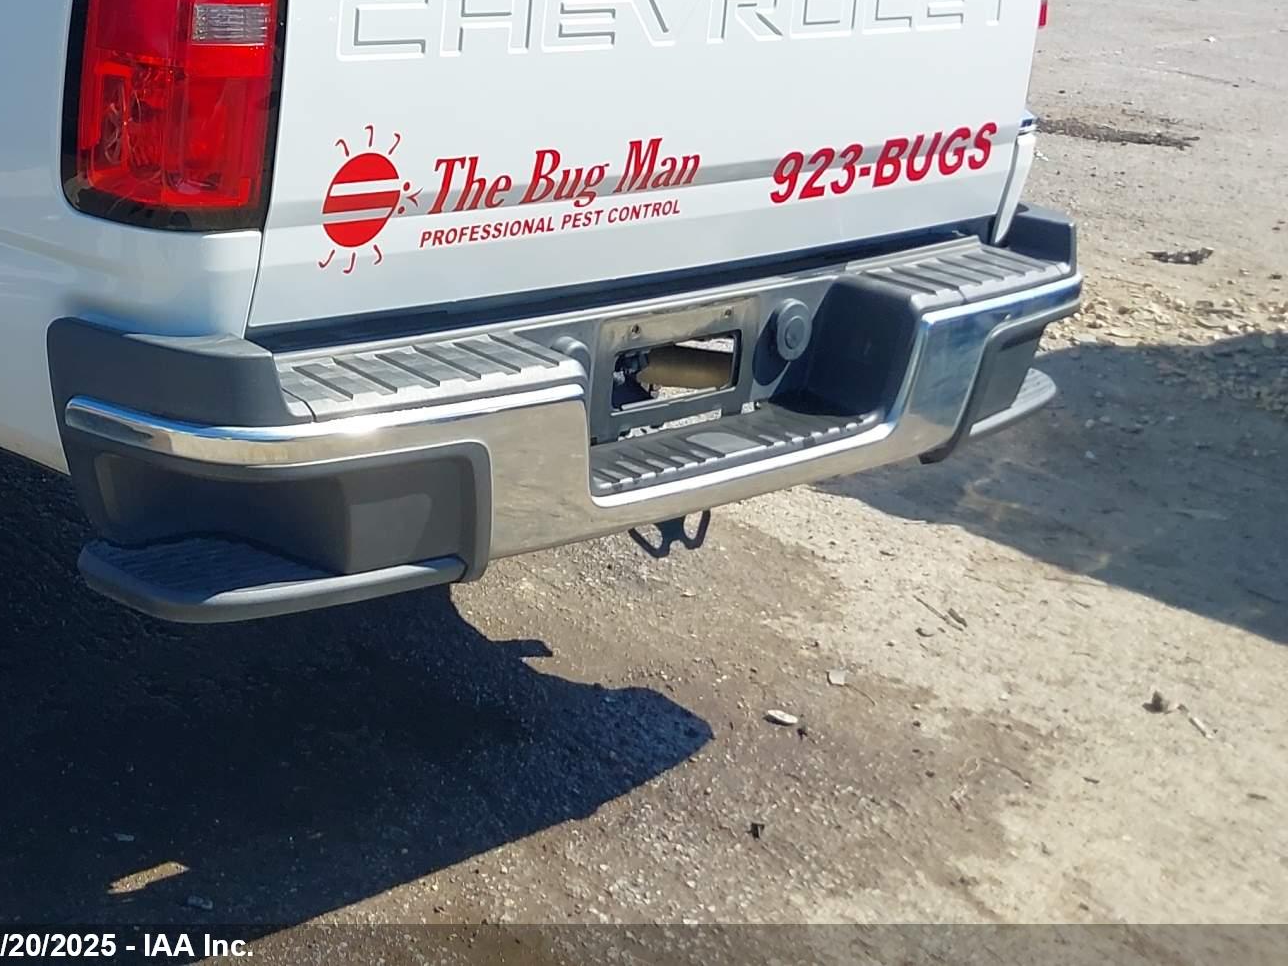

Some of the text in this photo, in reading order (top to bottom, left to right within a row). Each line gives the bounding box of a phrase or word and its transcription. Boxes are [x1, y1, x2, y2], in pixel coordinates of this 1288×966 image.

[427, 137, 701, 215] The Bug Man
[769, 121, 998, 204] 923-BUGS
[419, 199, 681, 248] PROFESSIONAL PEST CONTROL
